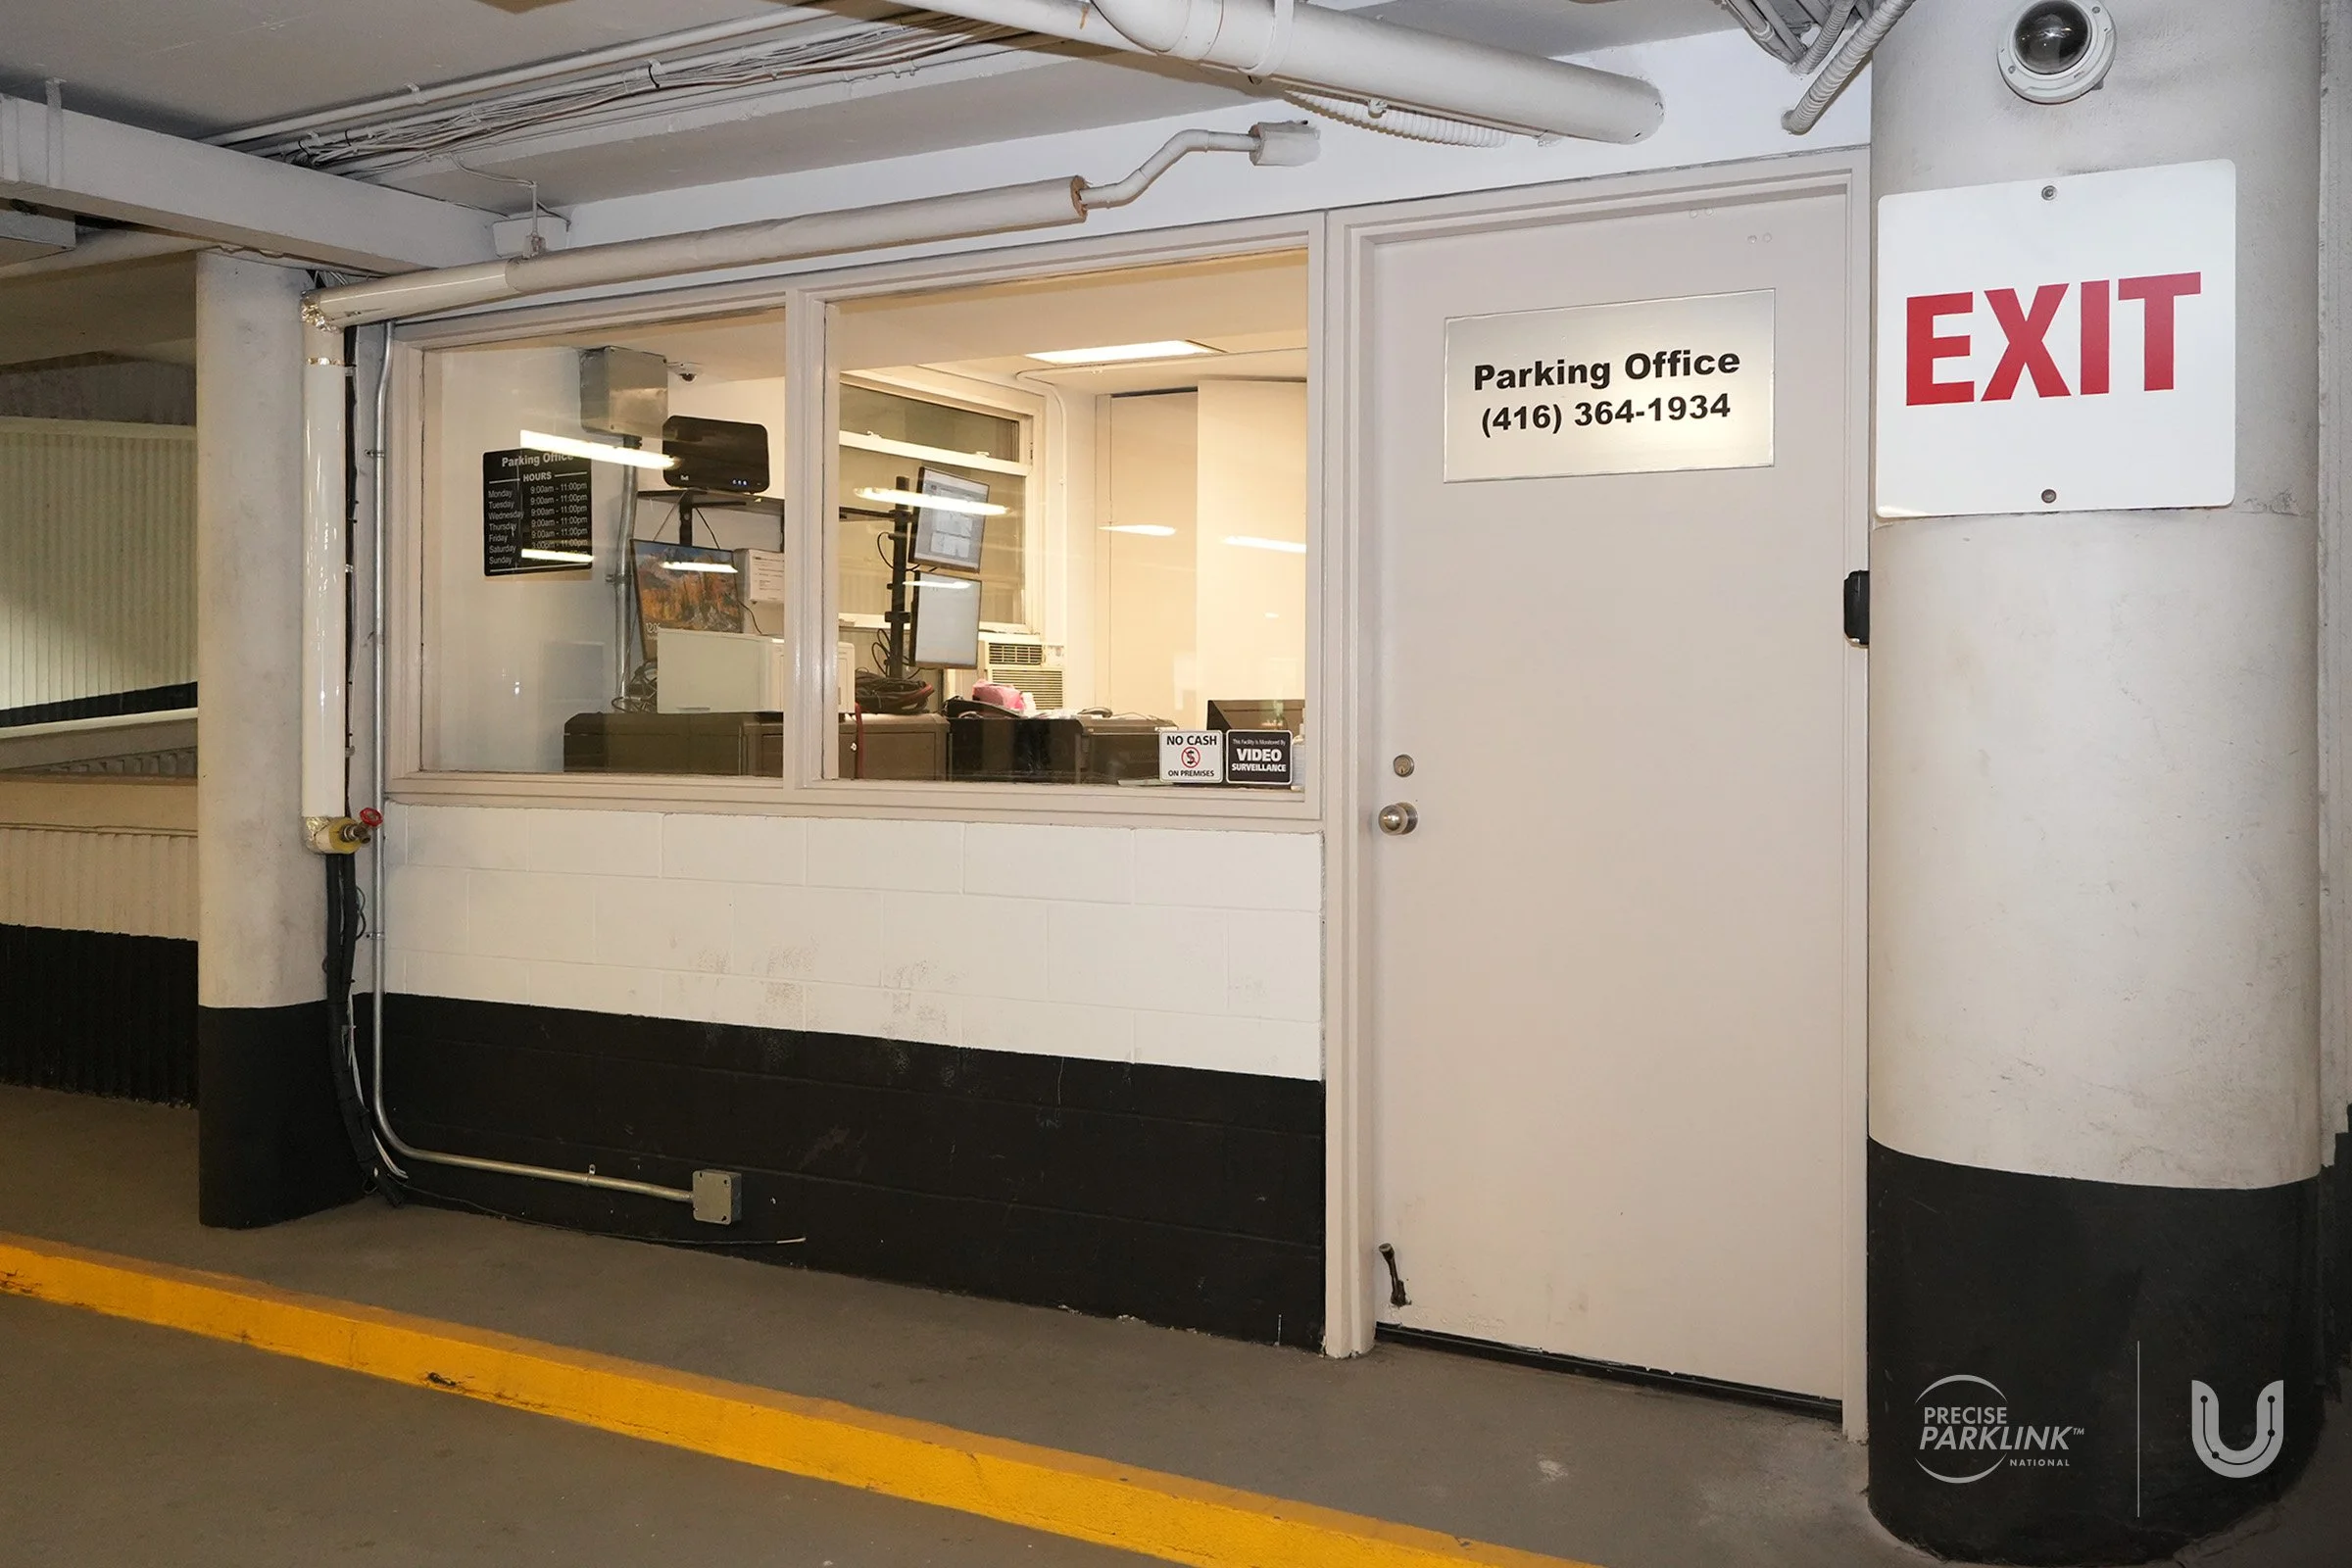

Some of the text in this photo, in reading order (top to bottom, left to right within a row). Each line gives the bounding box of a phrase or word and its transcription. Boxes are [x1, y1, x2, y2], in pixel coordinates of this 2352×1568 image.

[1907, 271, 2201, 406] EXIT
[1474, 349, 1740, 390] Parking Office
[1482, 393, 1731, 437] (416) 364-1934
[502, 455, 540, 467] Parking
[523, 471, 552, 482] HOURS
[488, 489, 513, 499] Monday
[561, 482, 587, 491] 11:00pm
[488, 501, 514, 510] Tuesday
[561, 494, 587, 503] 11:00pm
[488, 511, 524, 520] Wednesday
[561, 505, 587, 514] 11:00pm
[489, 522, 517, 531] Thursday
[561, 515, 587, 525] 11:00pm
[489, 534, 508, 543] Friday
[561, 527, 588, 536] 11:00pm
[489, 545, 516, 554] Saturday
[561, 538, 588, 548] 11:00pm
[489, 556, 513, 564] Sunday
[1166, 735, 1217, 745] NO CASH
[1237, 749, 1282, 761] VIDEO
[1232, 763, 1286, 772] SURVEILLANCE
